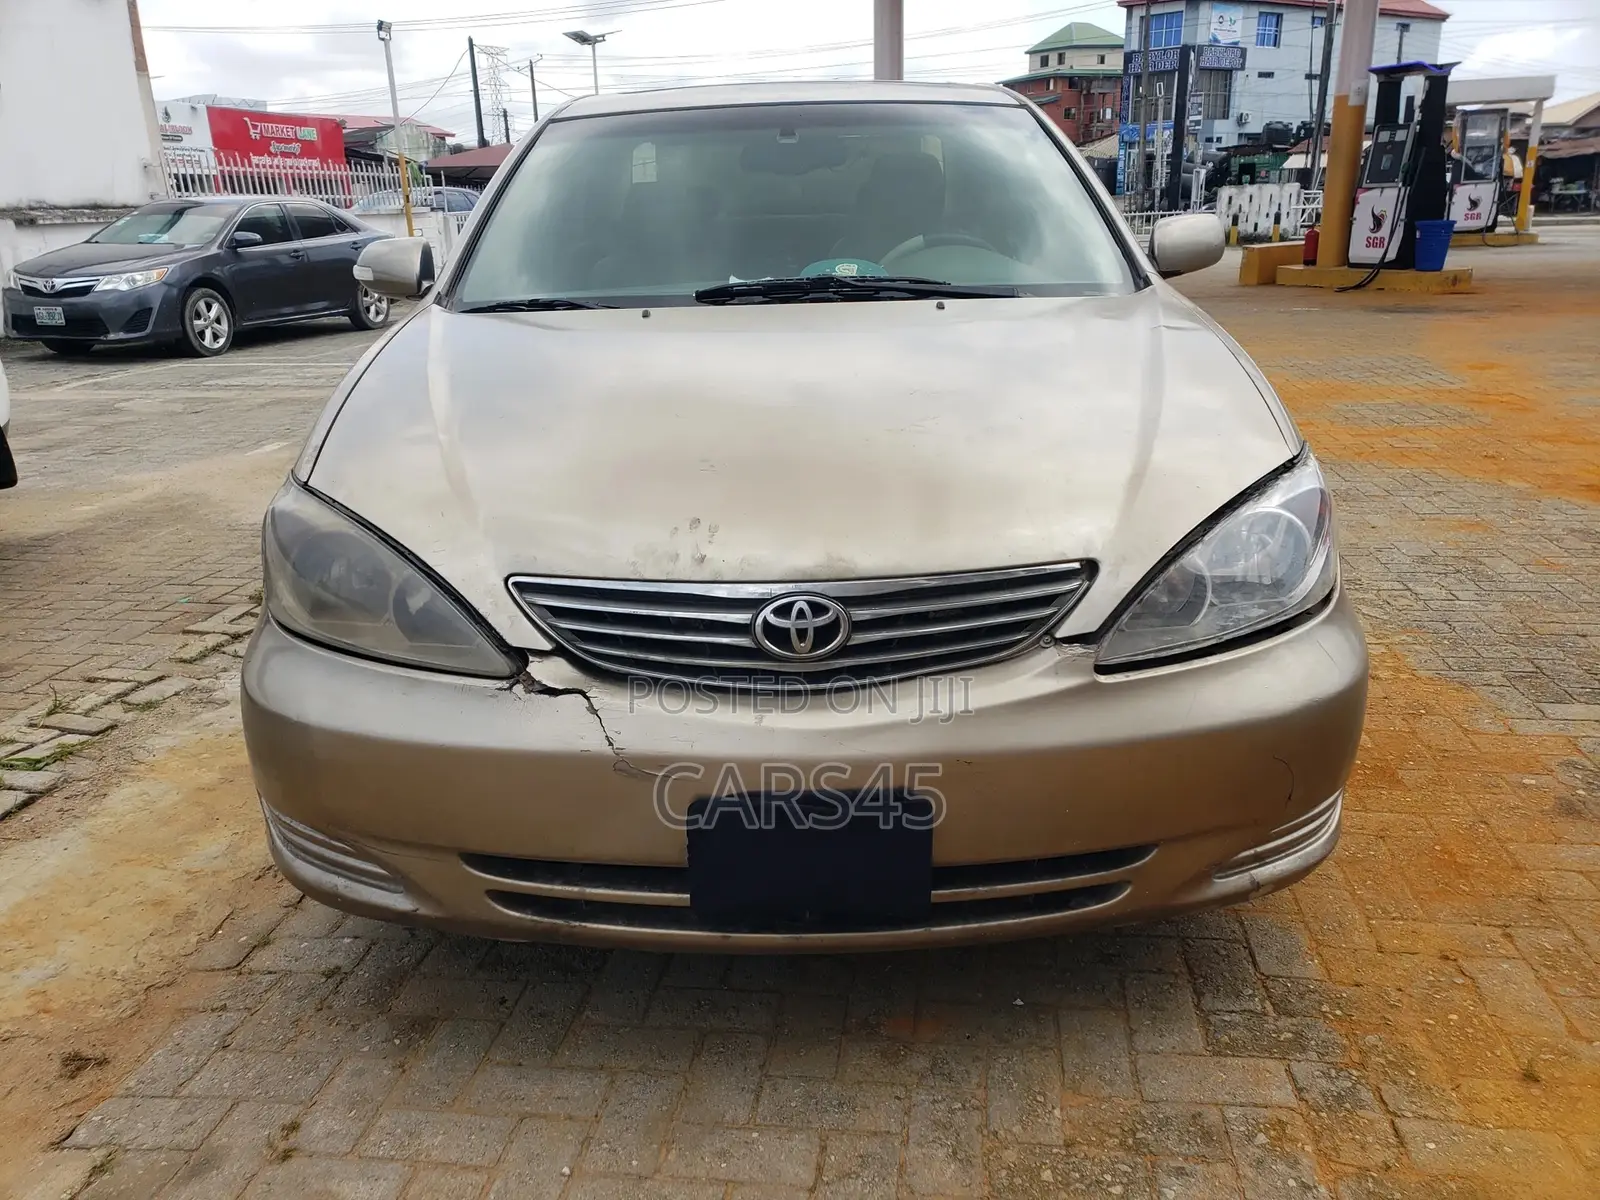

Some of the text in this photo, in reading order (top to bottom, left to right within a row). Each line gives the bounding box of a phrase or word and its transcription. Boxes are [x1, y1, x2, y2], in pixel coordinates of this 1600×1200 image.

[1132, 49, 1180, 62] BBYLOR
[262, 123, 318, 141] MARKET LANE
[1464, 212, 1482, 221] SGR
[1365, 236, 1386, 249] SGR
